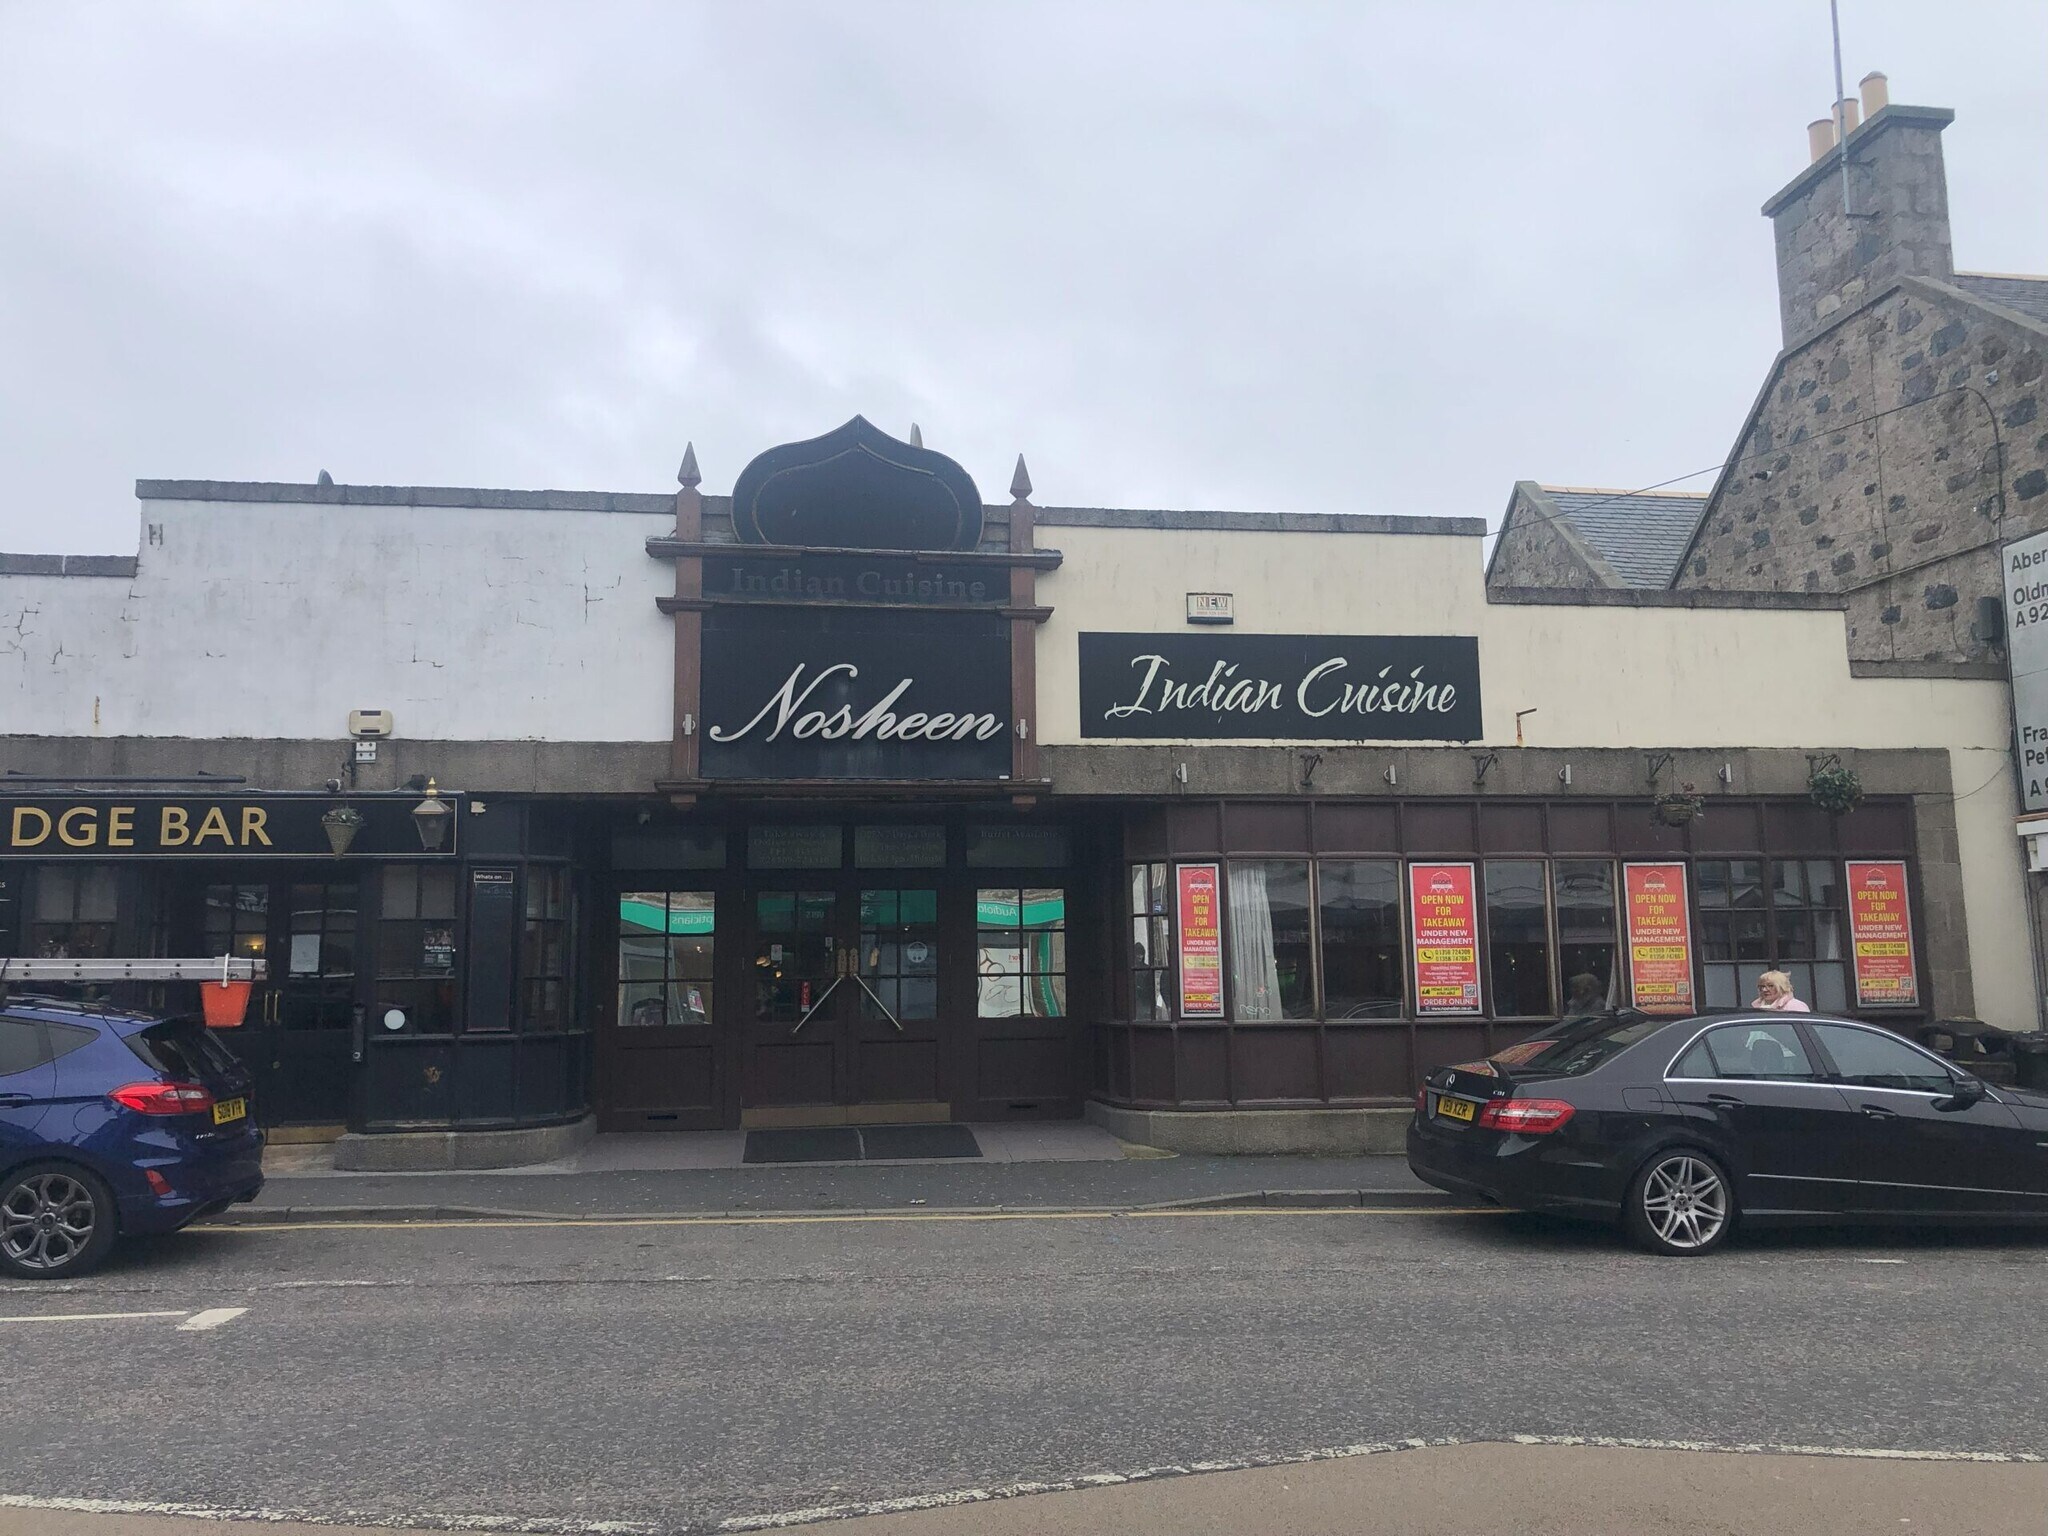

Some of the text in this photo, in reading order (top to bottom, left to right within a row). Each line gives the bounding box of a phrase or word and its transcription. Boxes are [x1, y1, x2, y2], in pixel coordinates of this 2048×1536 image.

[2011, 549, 2047, 573] Aber
[731, 568, 986, 598] Indian Cuisine
[1104, 654, 1457, 720] Indian Cuisine
[709, 662, 1004, 742] Nosheen
[11, 807, 273, 847] DGE BAR
[1192, 895, 1209, 904] OPEN
[1421, 895, 1464, 904] OPEN NOW
[1635, 894, 1676, 904] OPEN NOW
[1857, 891, 1897, 900] OPEN NOW
[1194, 906, 1209, 915] NOW
[1436, 906, 1451, 916] FOR
[1649, 906, 1664, 914] FOR
[1871, 902, 1886, 911] FOR
[1195, 917, 1207, 926] FOR
[1422, 917, 1466, 927] TAKEAWAY
[1636, 916, 1678, 926] TAKEAWAY
[1858, 912, 1899, 922] TAKEAWAY
[1184, 928, 1218, 937] TAKEAWAY
